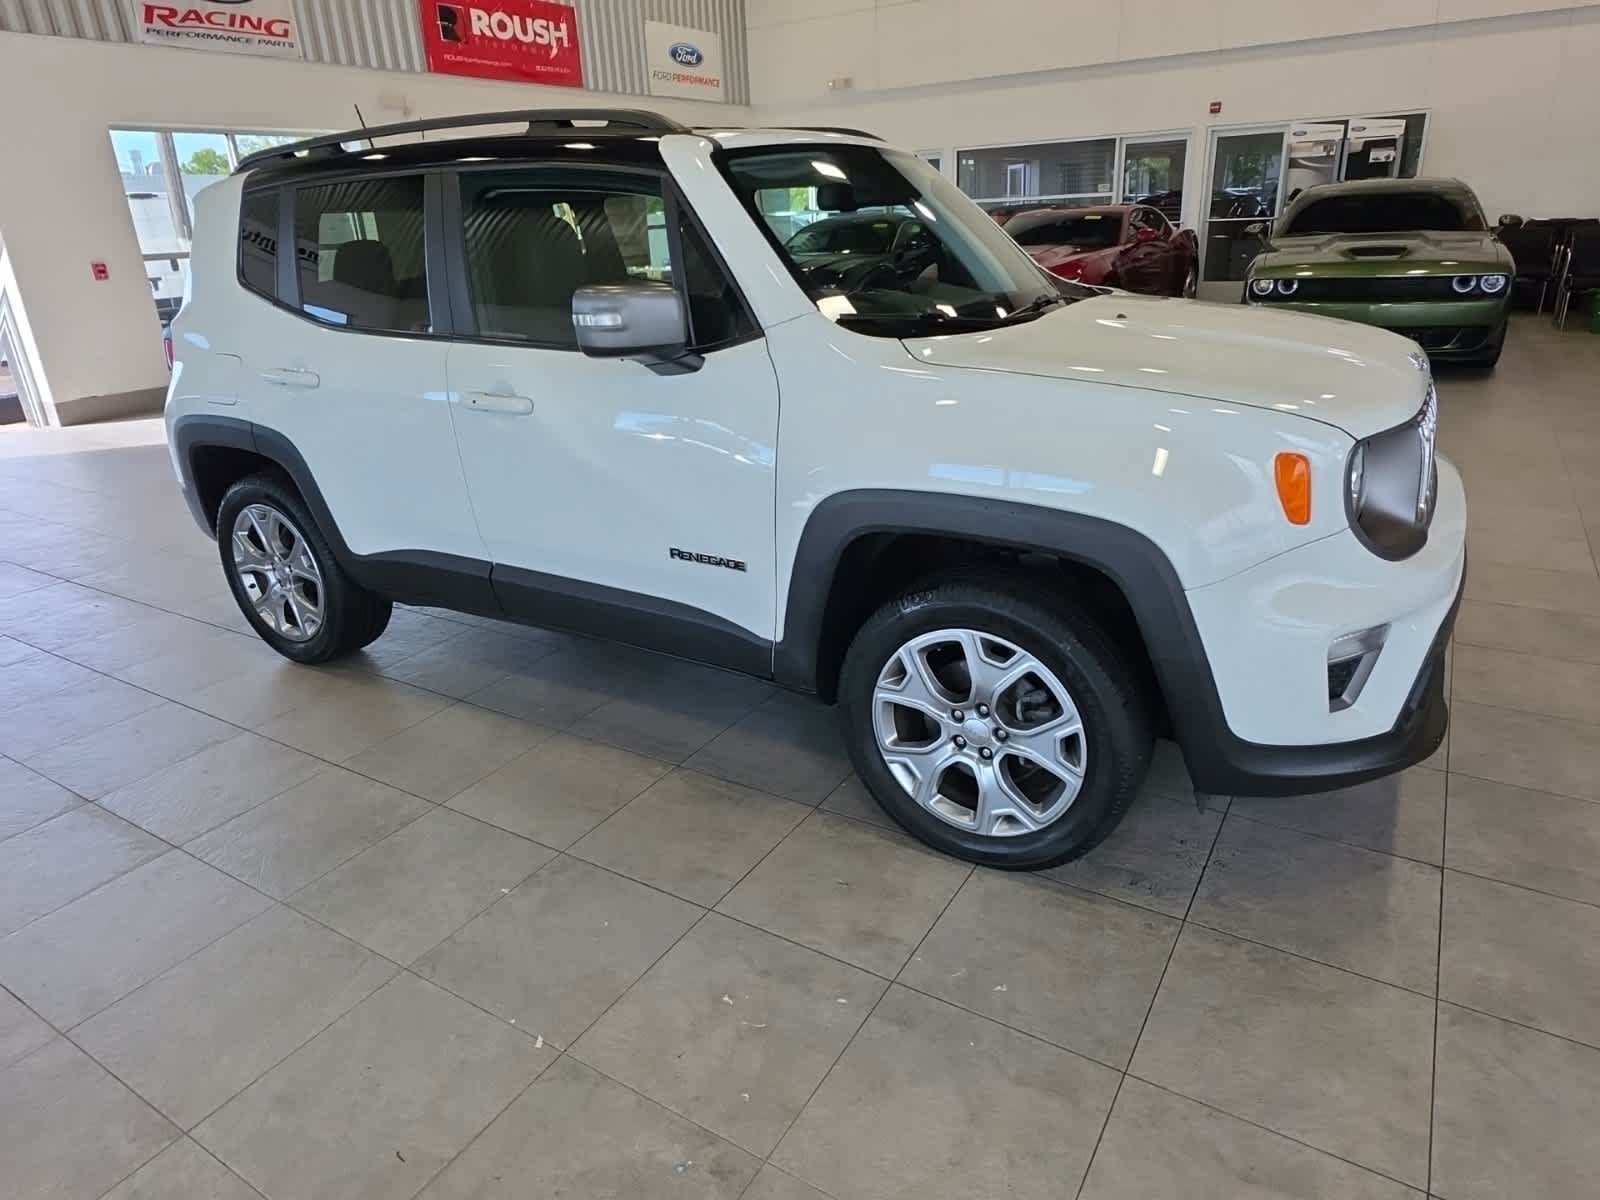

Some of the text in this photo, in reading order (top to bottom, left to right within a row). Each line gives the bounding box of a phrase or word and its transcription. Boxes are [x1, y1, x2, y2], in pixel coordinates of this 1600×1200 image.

[143, 4, 290, 38] RACING
[146, 27, 295, 48] PERFORMANCE PARTS
[469, 7, 569, 60] ROUSH
[675, 46, 697, 63] Ford
[672, 73, 720, 88] PERFORMANCE
[669, 547, 747, 573] RENEGADE
